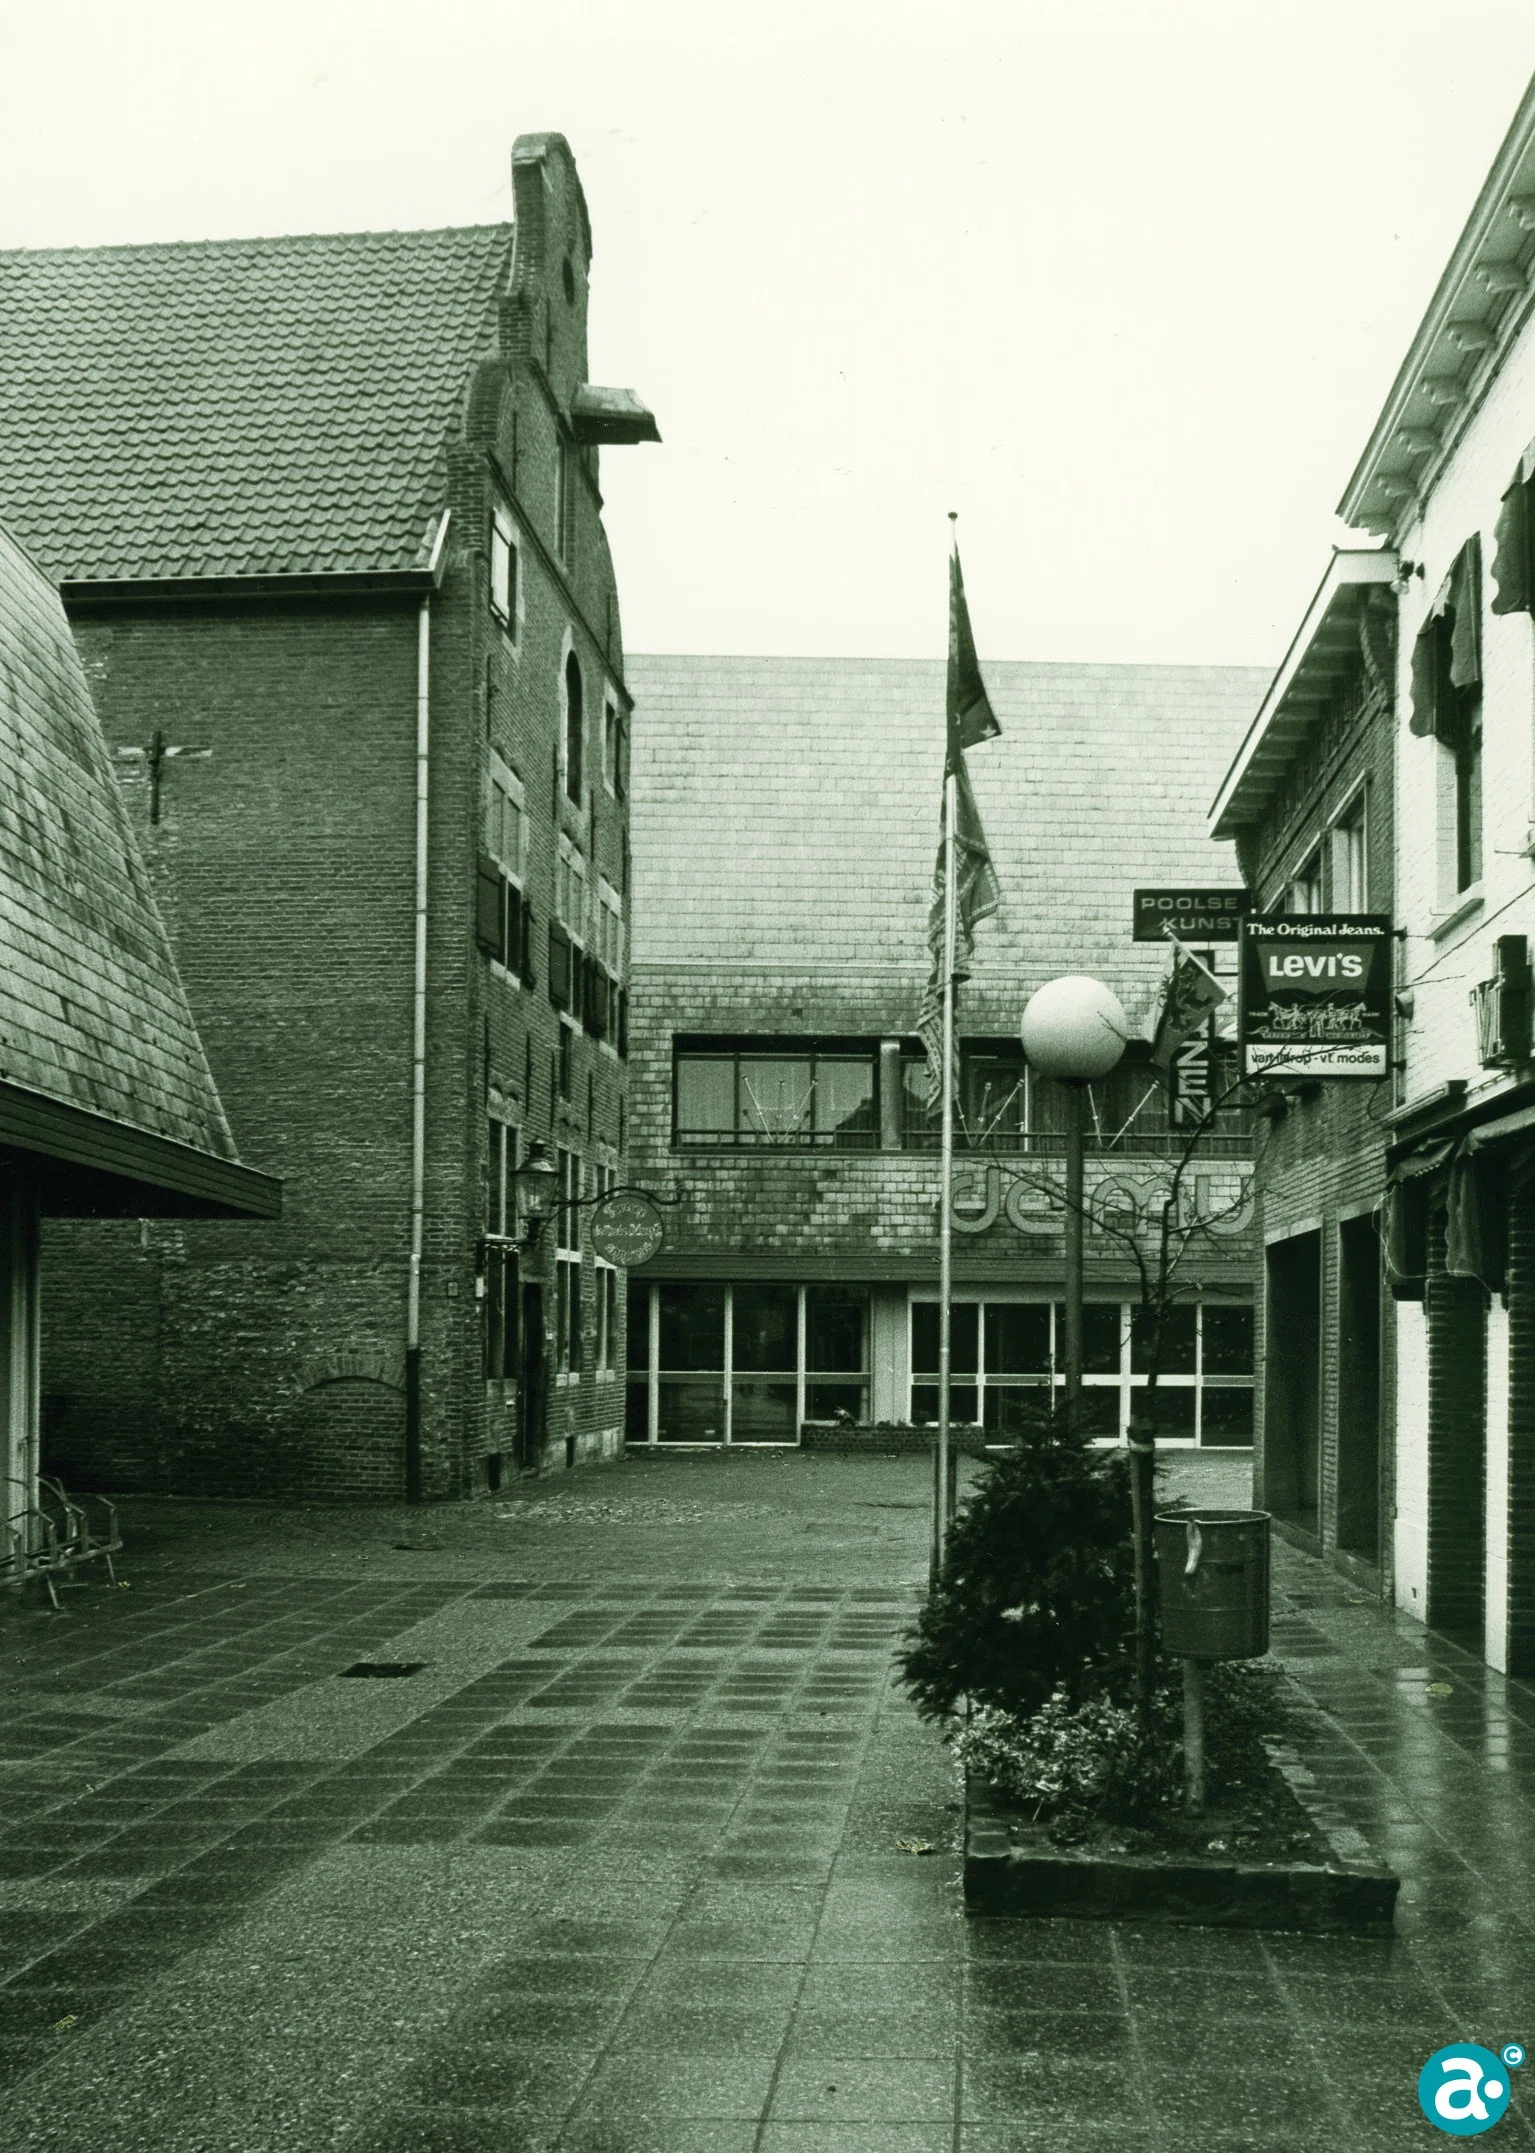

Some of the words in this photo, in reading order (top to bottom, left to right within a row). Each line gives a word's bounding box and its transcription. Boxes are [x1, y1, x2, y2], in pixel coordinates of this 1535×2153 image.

[1140, 897, 1238, 910] POOLSE
[1246, 923, 1275, 935] The
[1277, 923, 1337, 938] Original
[1338, 923, 1386, 935] Jeans.
[1337, 1052, 1381, 1064] modes
